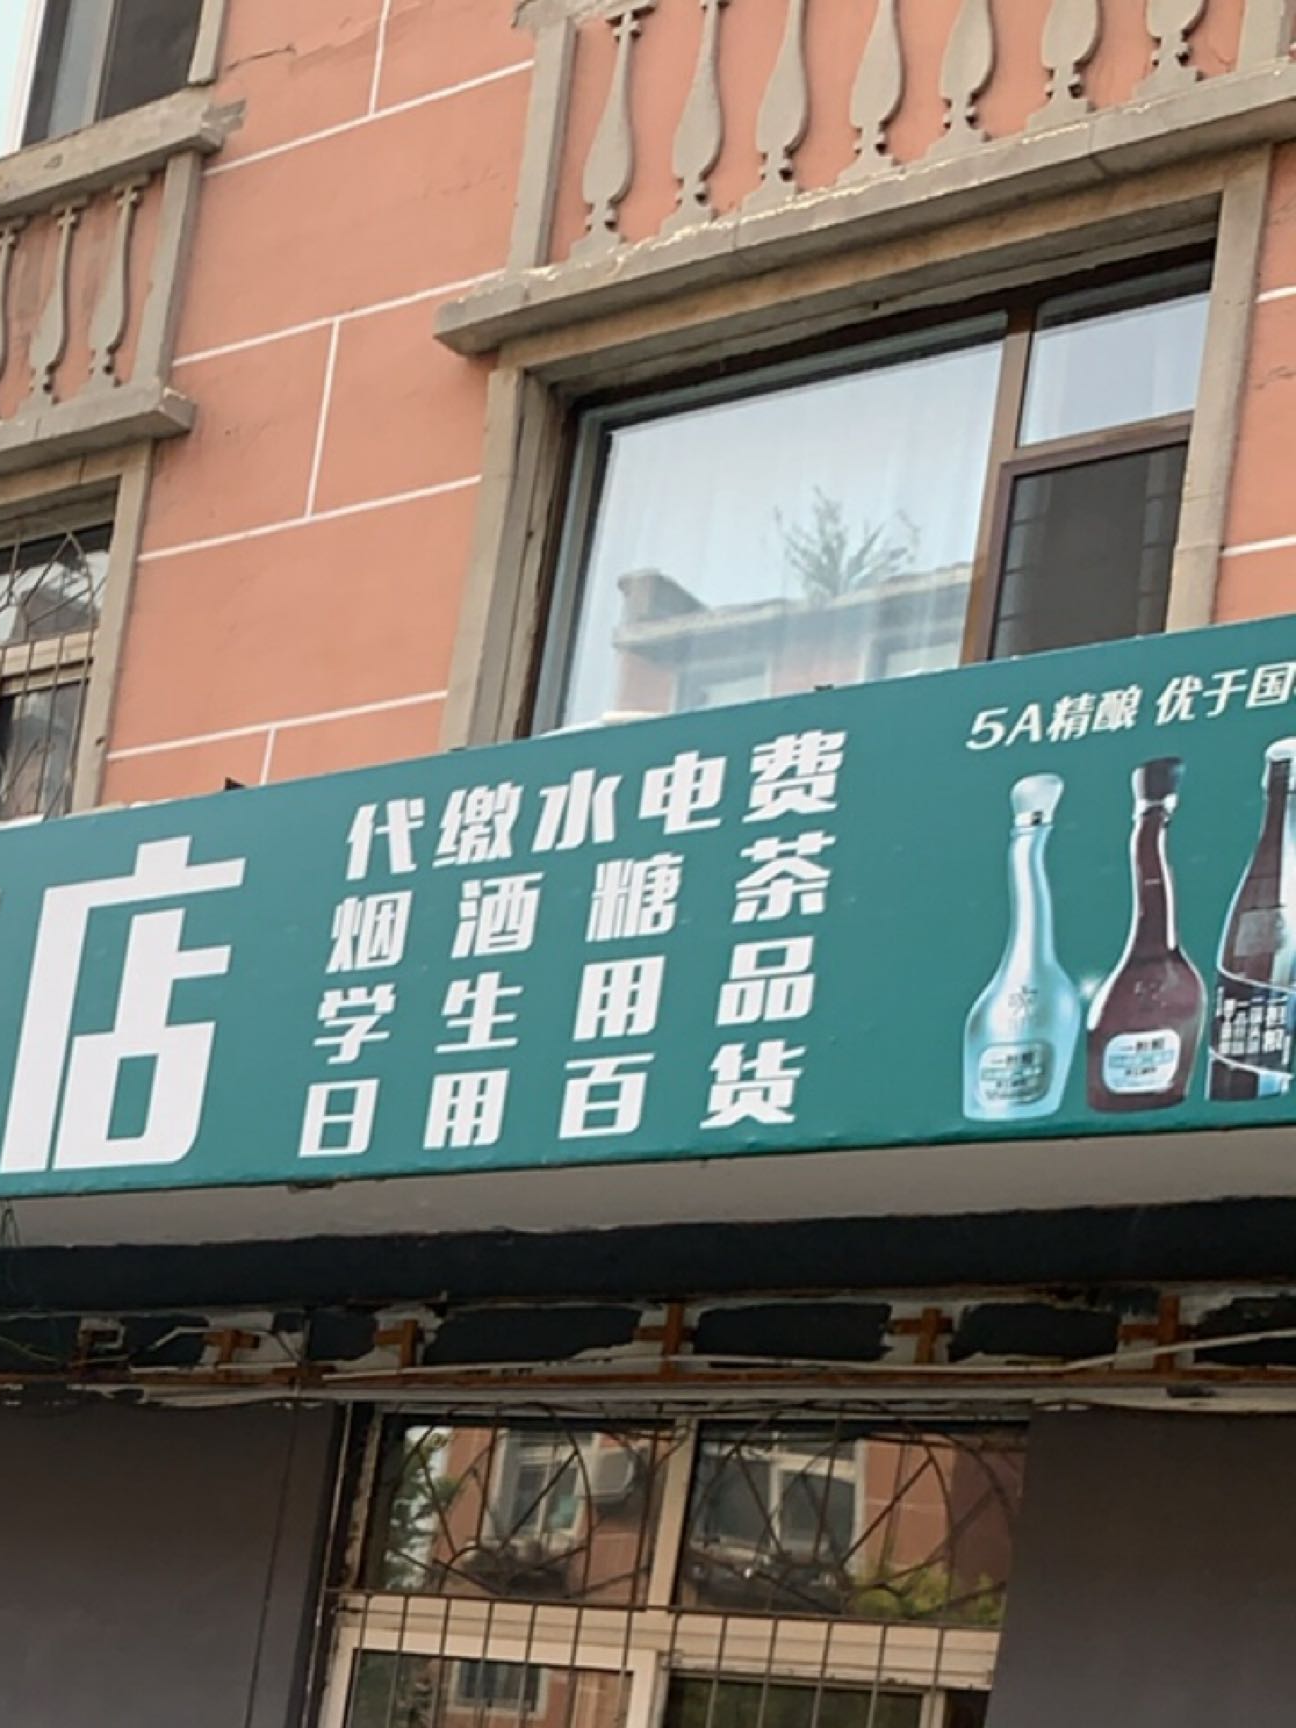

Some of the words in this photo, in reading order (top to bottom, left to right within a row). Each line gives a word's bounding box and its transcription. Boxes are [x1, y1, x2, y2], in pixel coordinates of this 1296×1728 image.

[966, 684, 1143, 750] 5A精酿
[1154, 662, 1296, 726] 优于国
[346, 729, 847, 881] 代缴水电费
[325, 831, 836, 973] 烟酒糖茶
[313, 936, 816, 1065] 学生用品
[298, 1039, 806, 1158] 日用百货
